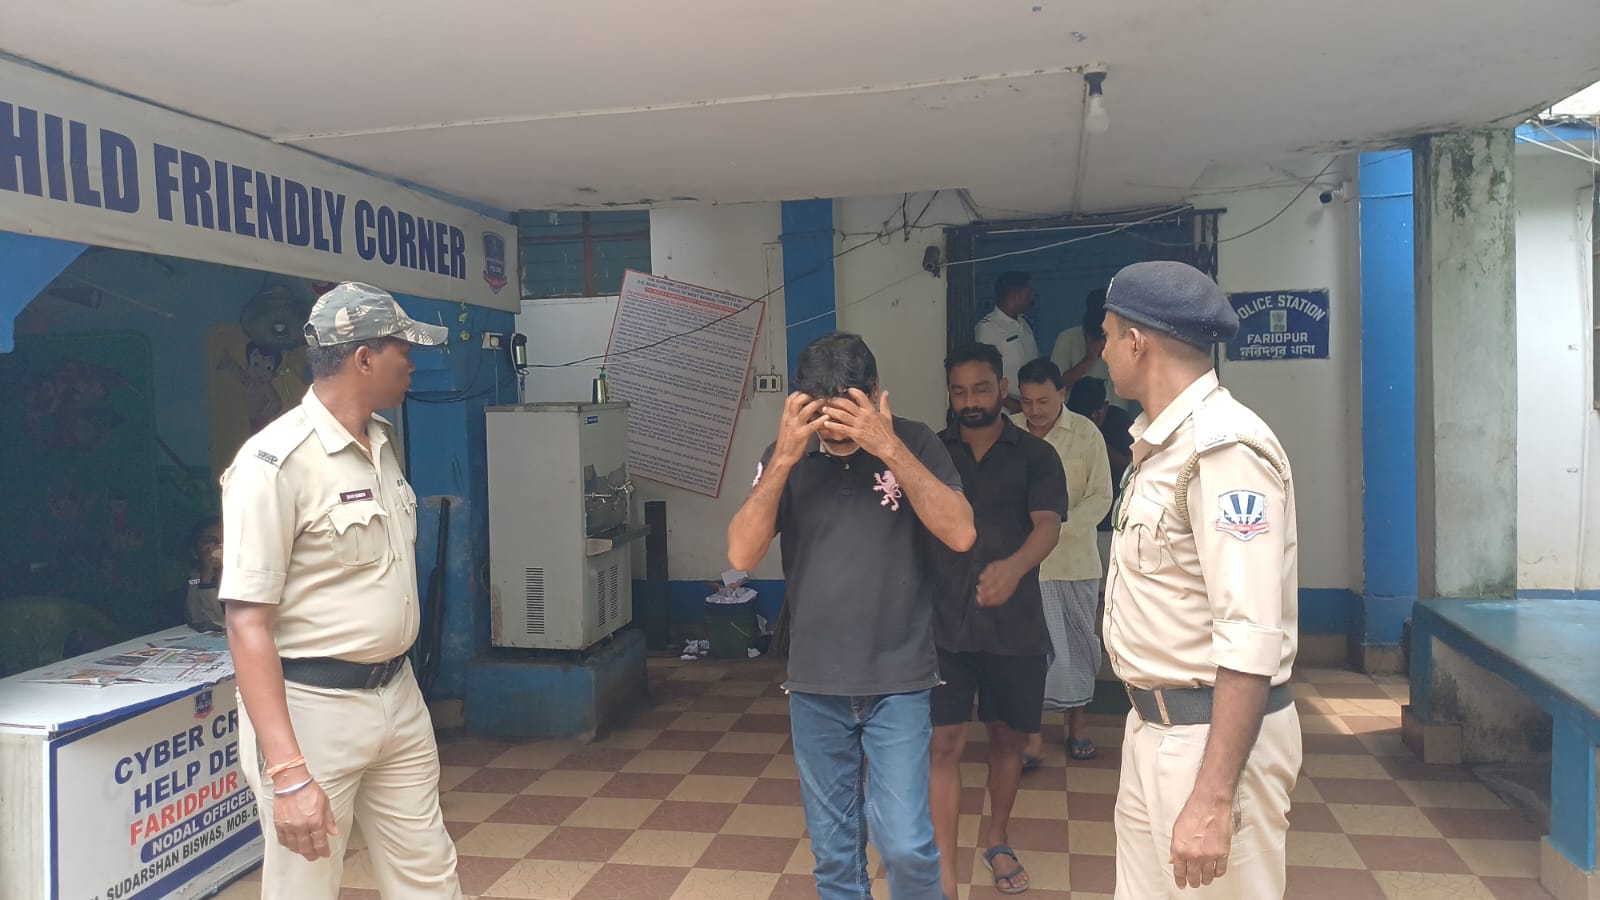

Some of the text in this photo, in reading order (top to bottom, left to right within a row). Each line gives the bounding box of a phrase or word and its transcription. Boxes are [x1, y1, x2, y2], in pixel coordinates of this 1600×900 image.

[0, 101, 467, 281] HILD FRIENDLY CORNER
[1237, 294, 1326, 322] OLICE STATION
[1247, 332, 1308, 344] FARIDPUR
[114, 725, 205, 785] CYBER
[134, 741, 238, 814] HELP DE
[130, 771, 238, 846] FARIDPUR
[152, 788, 256, 856] NODAL OFFICER
[107, 850, 179, 900] SUDARSHAN
[182, 826, 225, 860] BISWAS,
[227, 808, 250, 833] MOB-
